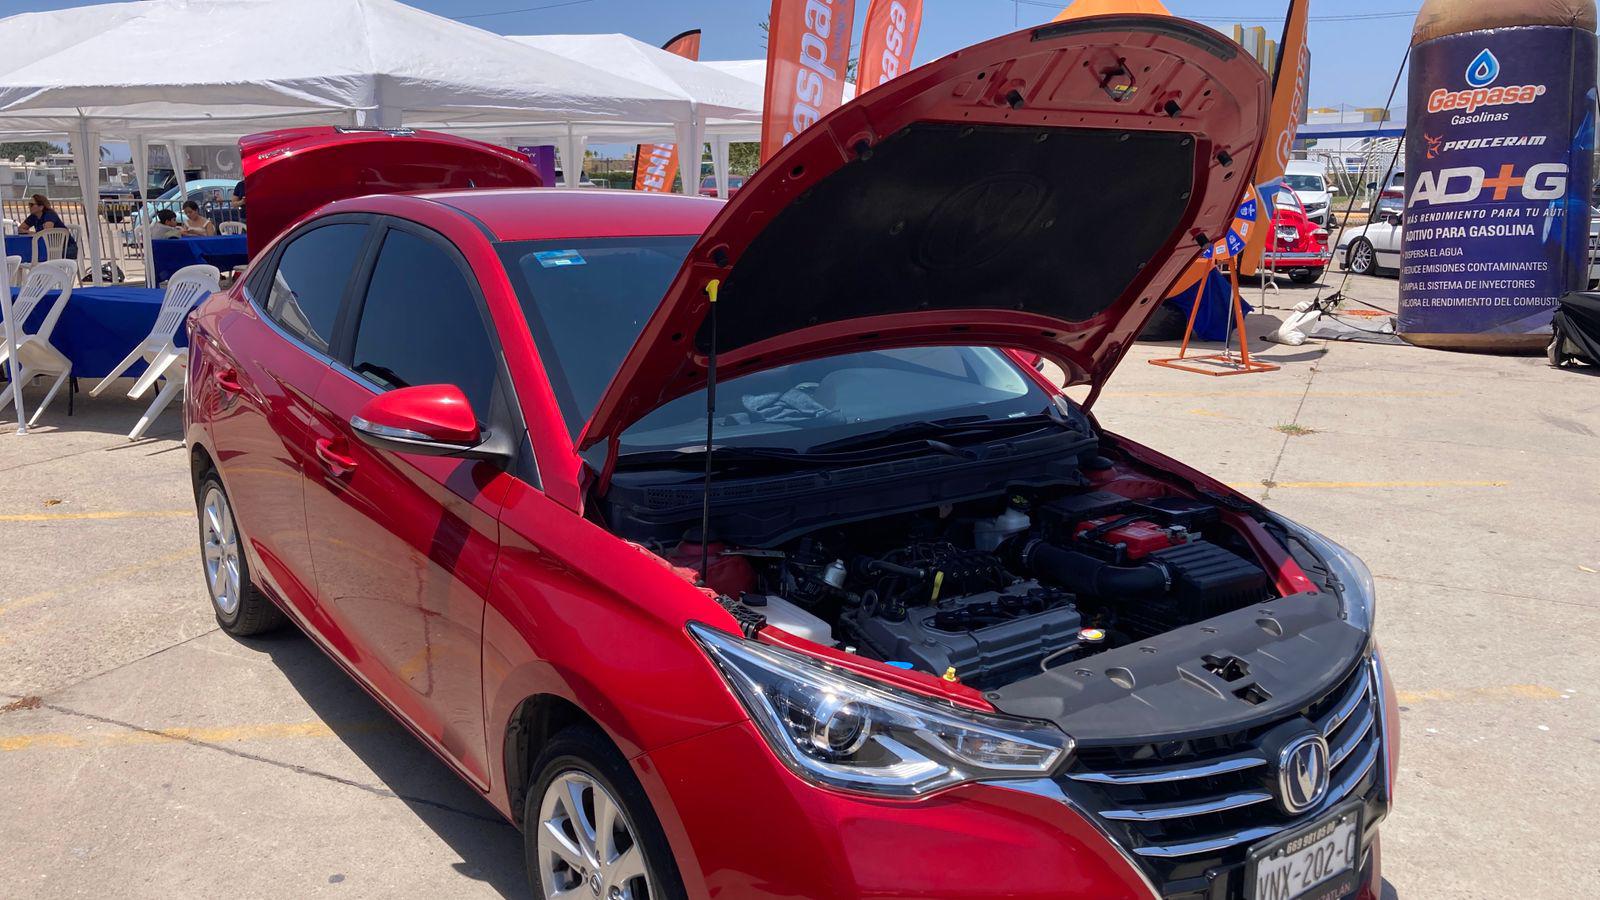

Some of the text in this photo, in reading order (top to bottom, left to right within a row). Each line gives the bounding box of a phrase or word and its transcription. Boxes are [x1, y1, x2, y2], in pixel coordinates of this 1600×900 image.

[1427, 85, 1534, 114] Gaspasa
[1451, 111, 1509, 125] Gasolinas
[1443, 135, 1546, 151] PROCERAM
[1407, 163, 1568, 208] AD+G
[1420, 210, 1486, 222] RENDIMIENTO
[1490, 208, 1520, 218] PARA
[1526, 208, 1539, 217] TU
[1405, 224, 1535, 242] ADITIVO PARA GASOLINA
[1430, 249, 1438, 257] EL
[1439, 247, 1464, 257] AGUA
[1422, 263, 1465, 274] EMISIONES
[1467, 261, 1548, 272] CONTAMINANTES
[1419, 282, 1427, 290] EL
[1427, 281, 1462, 290] SISTEMA
[1465, 280, 1477, 289] DE
[1479, 280, 1536, 289] INYECTORES
[1422, 298, 1430, 307] EL
[1431, 297, 1492, 307] RENDIMIENTO
[1494, 297, 1512, 307] DEL
